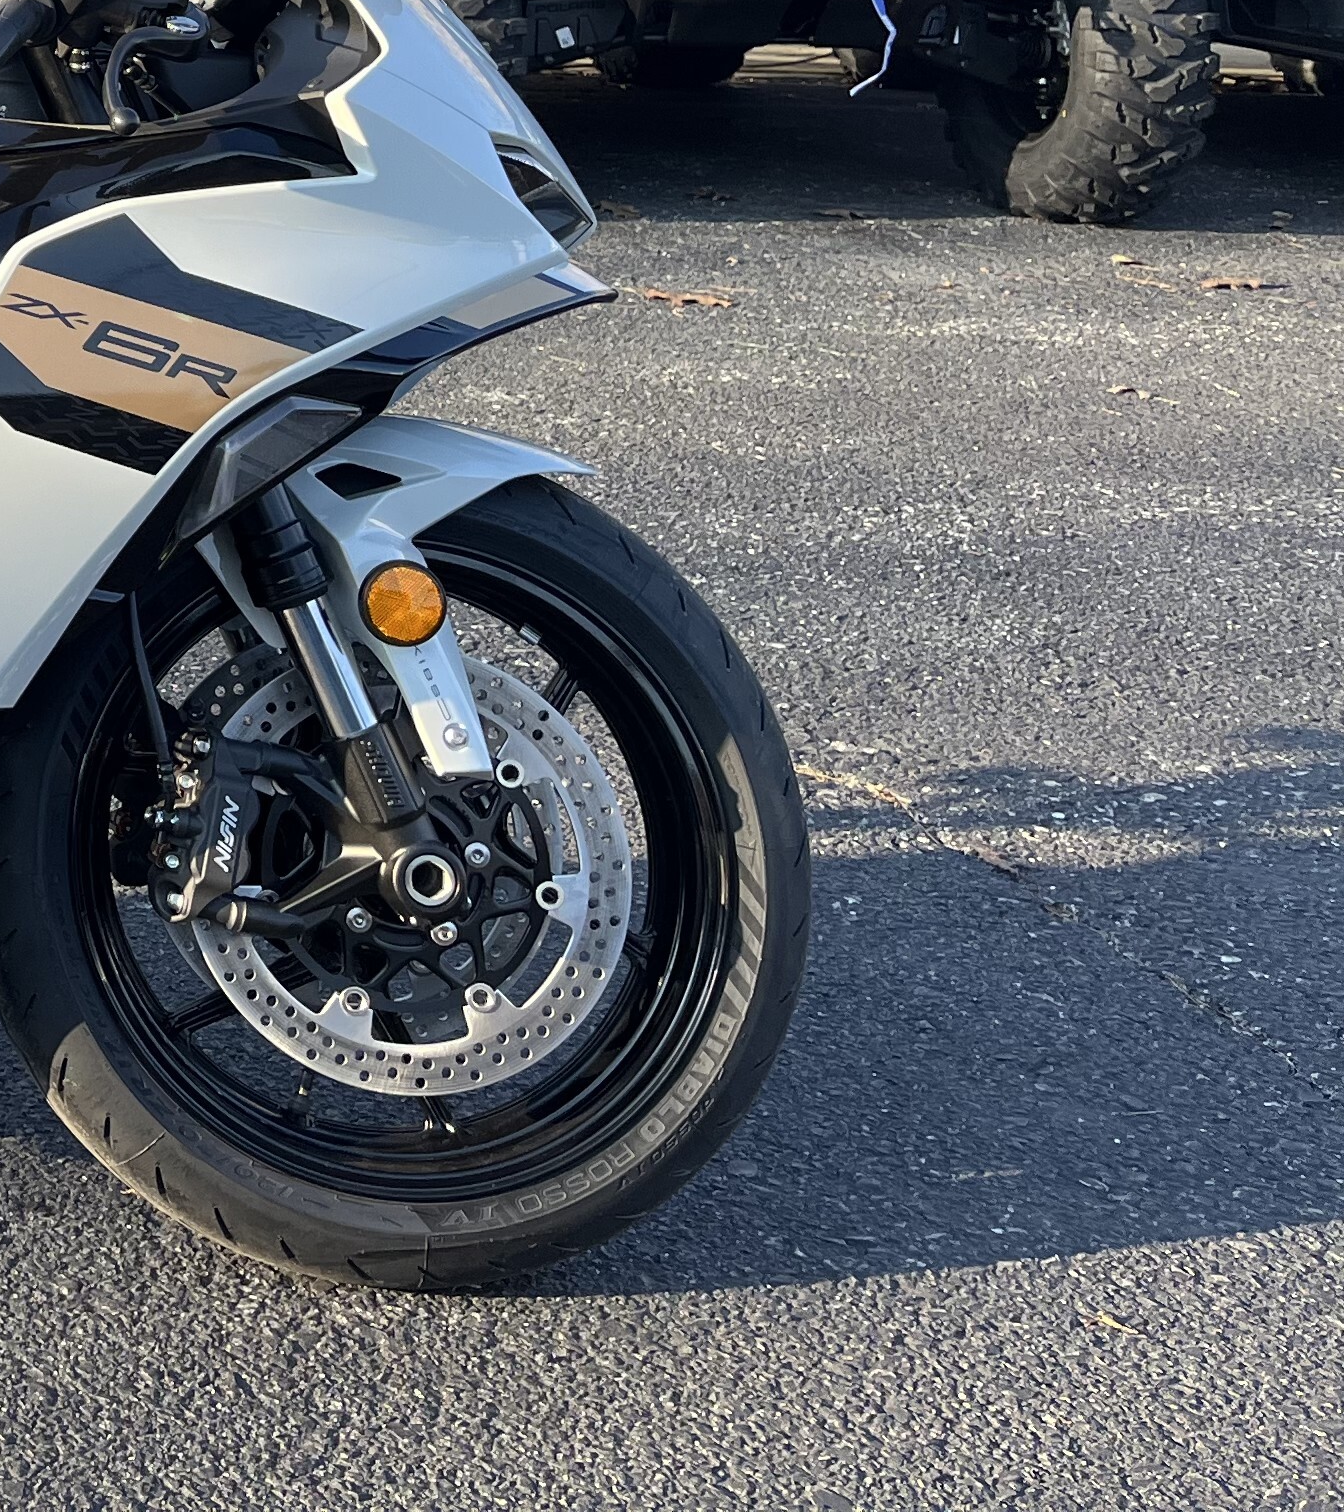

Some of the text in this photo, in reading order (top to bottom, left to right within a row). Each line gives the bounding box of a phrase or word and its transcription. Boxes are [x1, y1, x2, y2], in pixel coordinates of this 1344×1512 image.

[440, 1011, 738, 1227] DIABLO ROSSO IV
